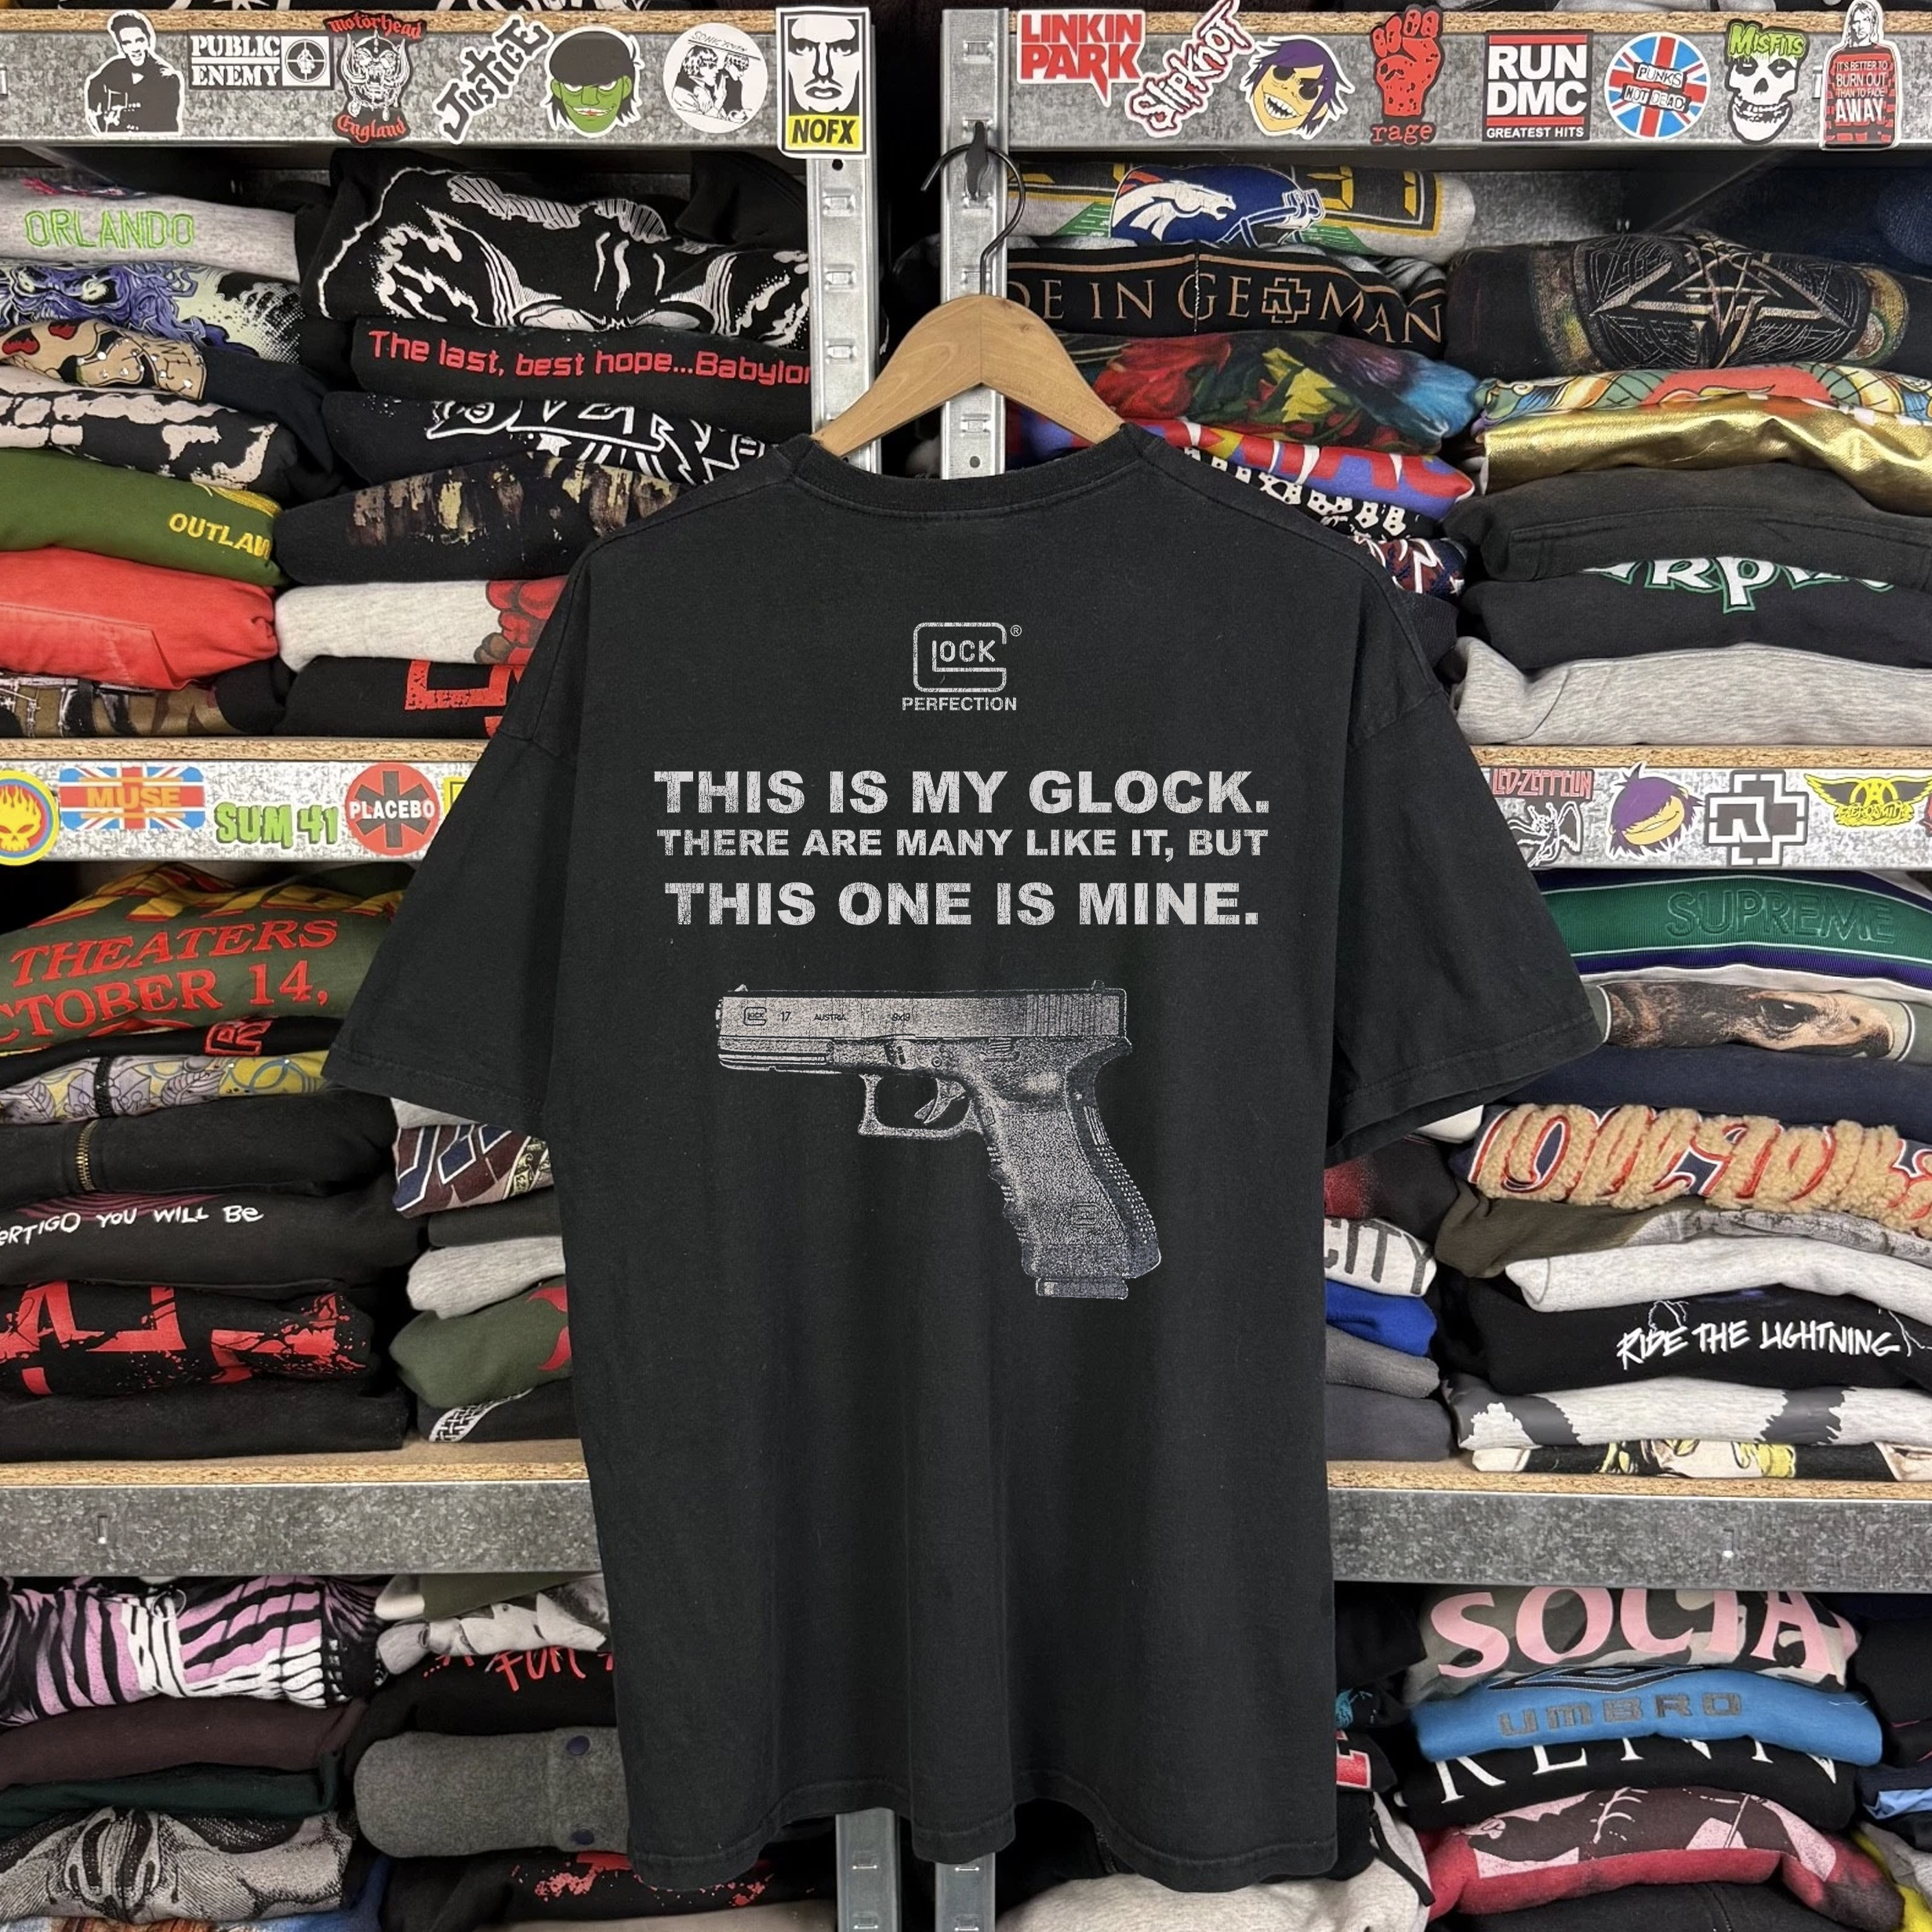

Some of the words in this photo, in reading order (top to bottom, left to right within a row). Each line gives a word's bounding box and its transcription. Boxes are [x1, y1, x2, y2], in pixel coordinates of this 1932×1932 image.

[1022, 14, 1142, 45] LINKIN
[191, 35, 280, 57] PUBLIC
[193, 64, 281, 86] ENEMY
[1022, 45, 1142, 97] PARK
[1490, 45, 1585, 78] RUN
[1850, 61, 1876, 71] BETTER
[1878, 61, 1887, 70] TO
[1638, 66, 1682, 86] PUNKS
[1836, 74, 1864, 87] BURN
[1866, 74, 1887, 87] OUT
[1487, 82, 1586, 115] DMC
[1625, 86, 1649, 103] NOT
[1651, 91, 1684, 110] DEAD
[1837, 88, 1856, 98] THAN
[1857, 88, 1866, 97] TO
[1867, 88, 1885, 97] FADE
[1836, 99, 1883, 122] AWAY
[792, 117, 856, 144] NOFX
[1372, 124, 1433, 144] rage
[1487, 126, 1550, 139] GREATEST
[1555, 125, 1584, 138] HITS
[25, 209, 194, 249] ORLANDO
[1091, 278, 1154, 320] IN
[369, 331, 430, 362] The
[438, 338, 504, 376] last,
[516, 353, 585, 376] best
[902, 697, 1017, 711] PERFECTION
[87, 788, 180, 809] MUSE
[656, 772, 805, 814] THIS
[831, 772, 888, 814] IS
[913, 772, 1008, 813] MY
[1030, 772, 1269, 814] GLOCK.
[348, 799, 435, 820] PLACEBO
[214, 801, 293, 848] SUM
[298, 802, 339, 845] 41
[658, 830, 790, 856] THERE
[803, 830, 882, 856] ARE
[898, 830, 1013, 856] MANY
[1028, 830, 1116, 856] LIKE
[1133, 830, 1174, 862] IT,
[1190, 830, 1269, 856] BUT
[666, 883, 815, 926] THIS
[840, 883, 971, 926] ONE
[998, 883, 1055, 926] IS
[1080, 884, 1258, 925] MINE.
[1666, 891, 1895, 943] SUPREME
[10, 920, 338, 988] THEATERS
[249, 960, 329, 1007] 14,
[780, 1011, 791, 1022] 17
[814, 1013, 847, 1022] AUSTRIA
[96, 1208, 137, 1228] YOU
[153, 1206, 209, 1223] WILL
[1616, 1324, 1690, 1370] RIDE
[1691, 1320, 1751, 1354] THE
[1759, 1320, 1901, 1357] LIGHTNING
